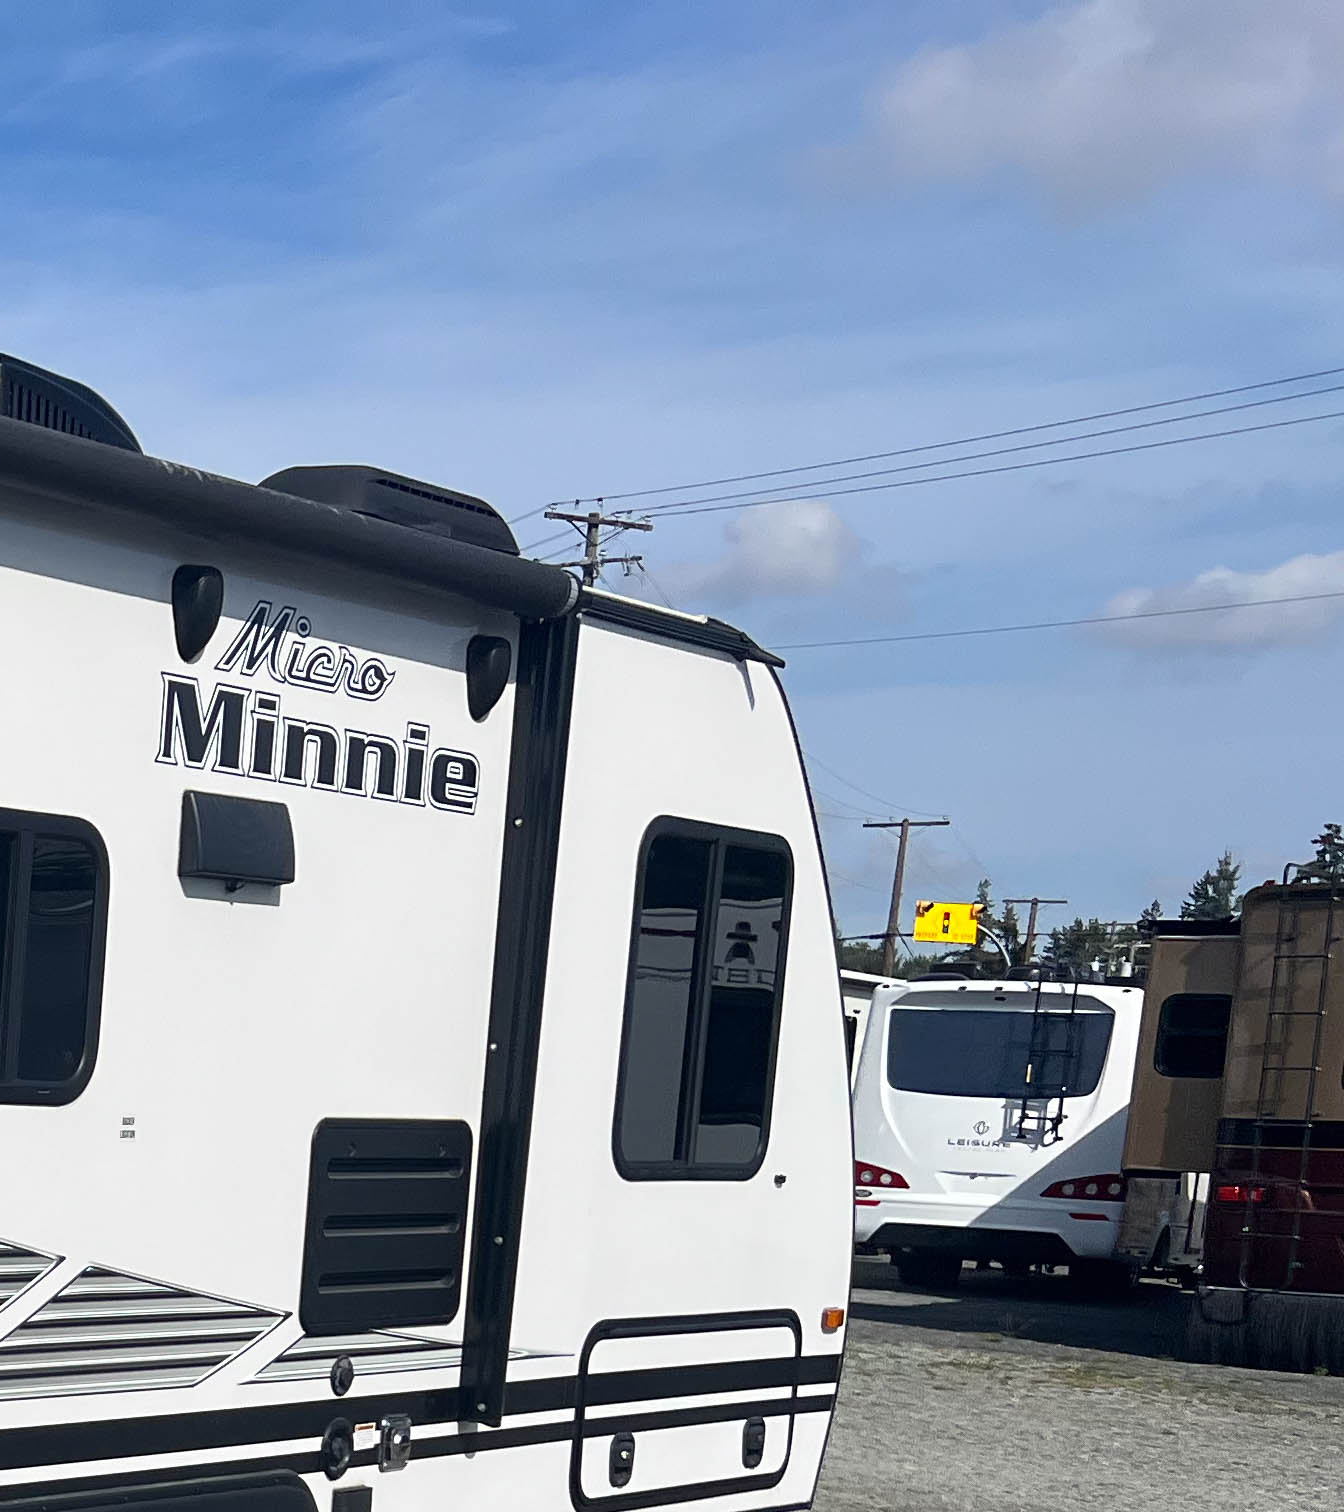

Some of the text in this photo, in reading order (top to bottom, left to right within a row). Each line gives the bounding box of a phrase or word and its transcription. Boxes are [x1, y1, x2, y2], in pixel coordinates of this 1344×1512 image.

[215, 599, 397, 701] Micro
[155, 672, 481, 815] Minnie
[947, 1138, 1011, 1149] LEISURE
